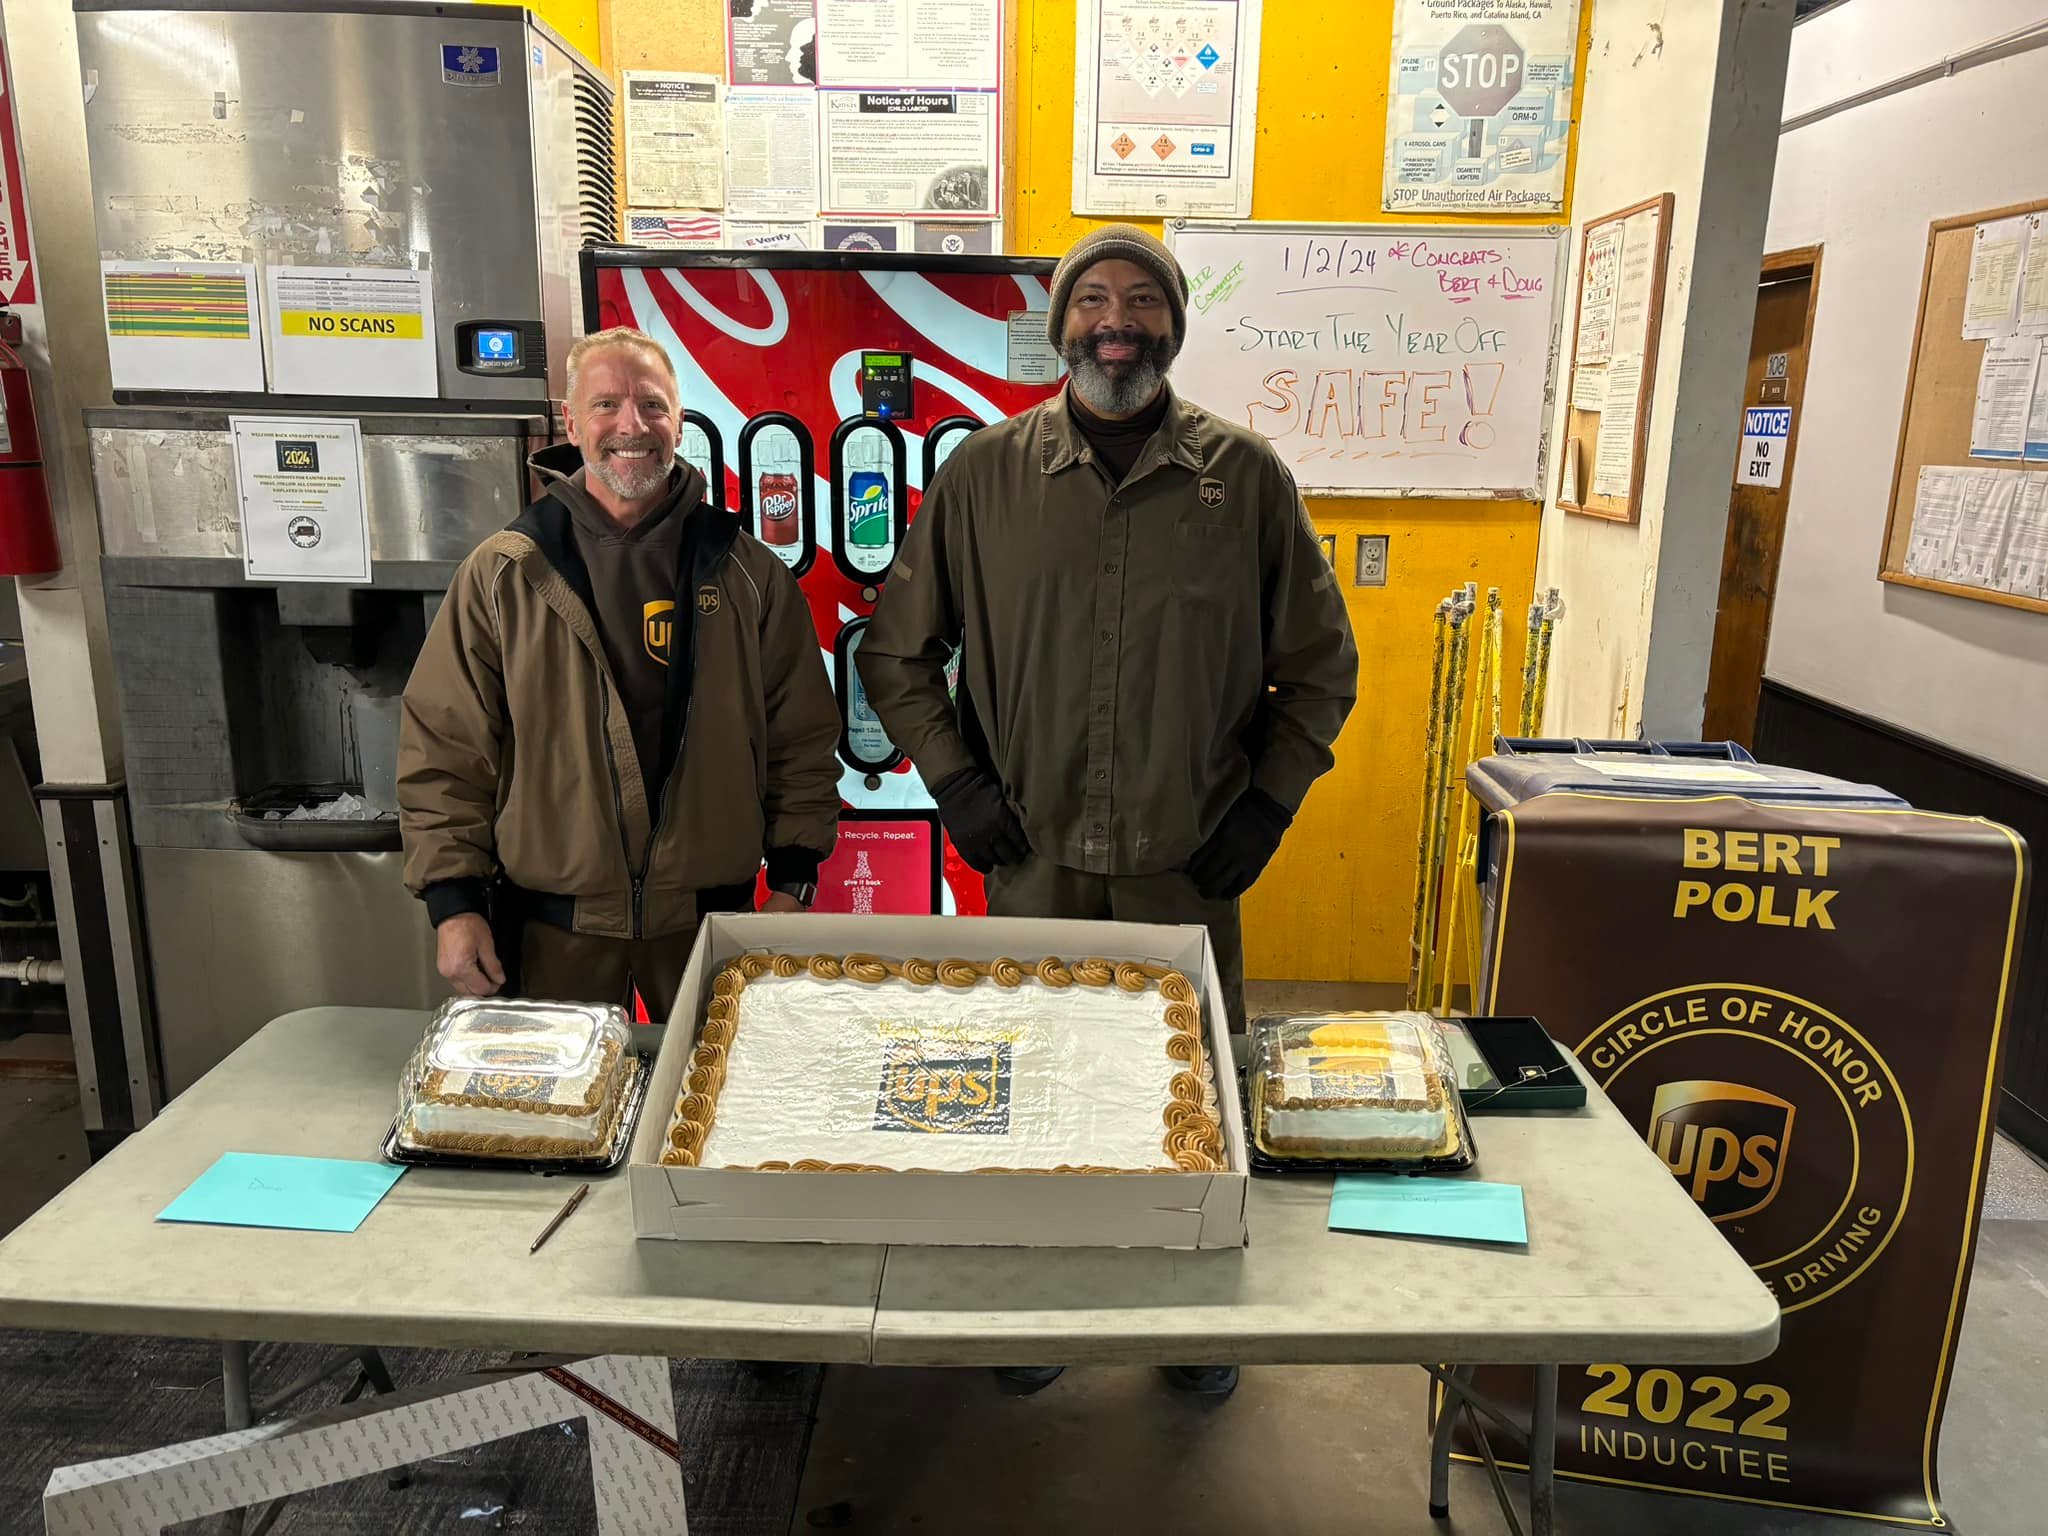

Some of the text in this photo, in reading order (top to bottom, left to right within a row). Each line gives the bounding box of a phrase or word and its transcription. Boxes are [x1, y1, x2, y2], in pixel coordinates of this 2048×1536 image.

[1427, 0, 1455, 8] Ground
[1458, 0, 1494, 10] Packages
[1430, 11, 1451, 19] Puerto
[1453, 11, 1468, 19] Rico,
[1470, 11, 1482, 19] and
[1484, 11, 1508, 19] Catalina
[1442, 53, 1520, 88] STOP
[867, 96, 948, 106] Notice of Hours
[1512, 112, 1537, 120] ORM-D
[1393, 189, 1551, 204] STOP Unauthorized Air Packages
[755, 233, 791, 244] Verify
[1283, 240, 1376, 278] 1/2/24
[308, 316, 395, 333] NO SCANS
[1769, 356, 1786, 376] 108
[1246, 362, 1505, 450] SAFE!
[1746, 412, 1789, 434] NOTICE
[285, 450, 310, 465] 2024
[1755, 441, 1769, 458] NO
[1749, 461, 1771, 478] EXIT
[774, 494, 786, 505] Dr
[1201, 484, 1224, 504] ups
[766, 496, 792, 516] Pepper
[850, 494, 888, 524] Sprite
[845, 831, 916, 842] Recycle. Repeat.
[1682, 828, 1841, 878] BERT
[1673, 880, 1840, 930] POLK
[1591, 996, 1884, 1108] CIRCLE OF HONOR
[895, 1066, 990, 1118] ups
[1654, 1118, 1776, 1202] ups
[1790, 1202, 1882, 1296] DRIVING
[1580, 1364, 1792, 1442] 2022
[1580, 1424, 1792, 1484] INDUCTEE
